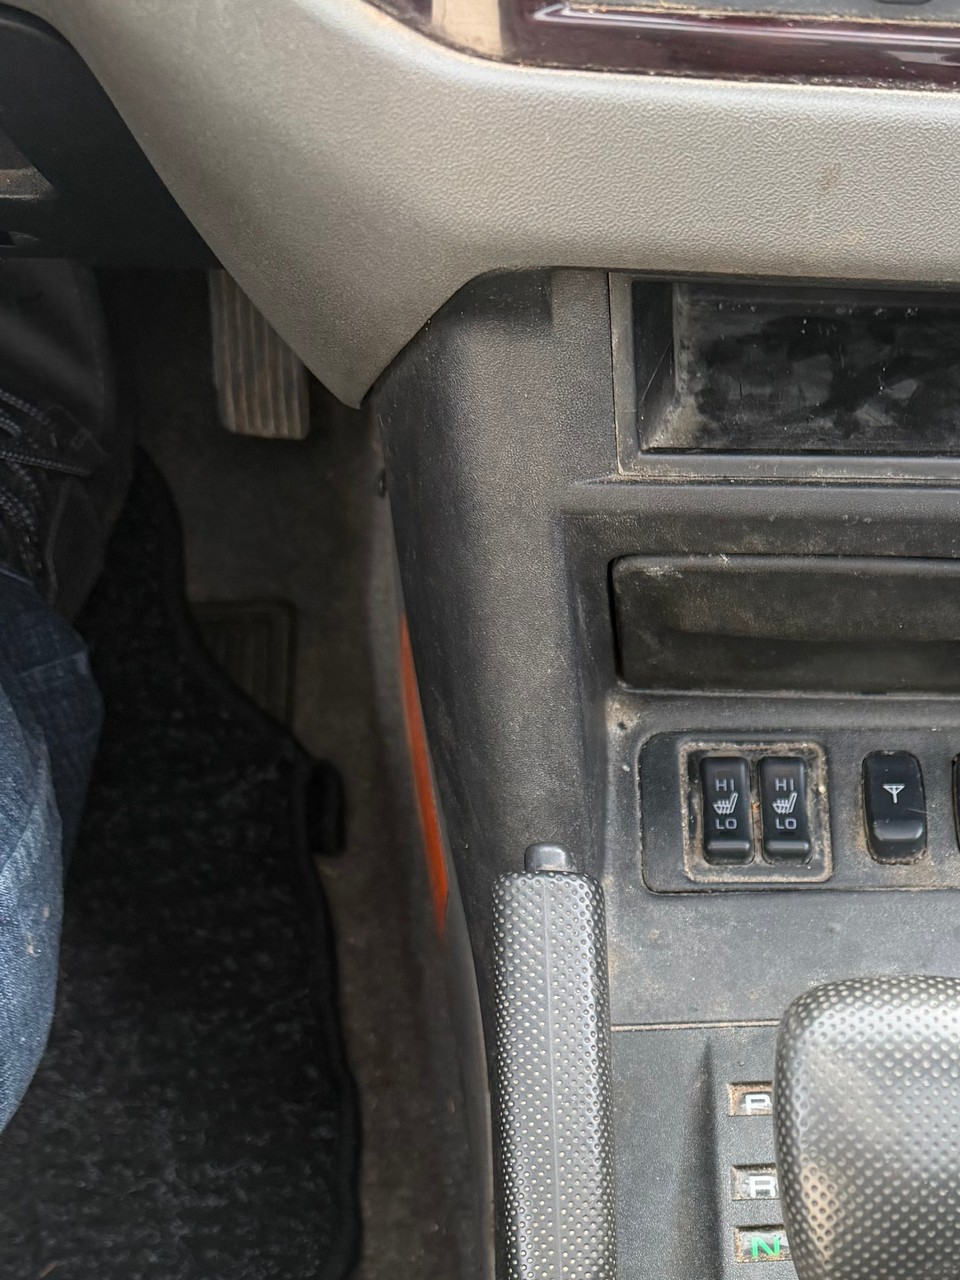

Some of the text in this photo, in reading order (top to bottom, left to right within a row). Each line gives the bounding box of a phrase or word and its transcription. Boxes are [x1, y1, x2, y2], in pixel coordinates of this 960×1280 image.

[715, 778, 735, 792] HI
[775, 777, 794, 791] HI
[715, 818, 738, 830] LO
[775, 818, 797, 830] LO
[745, 1094, 770, 1110] P
[751, 1236, 781, 1258] N
